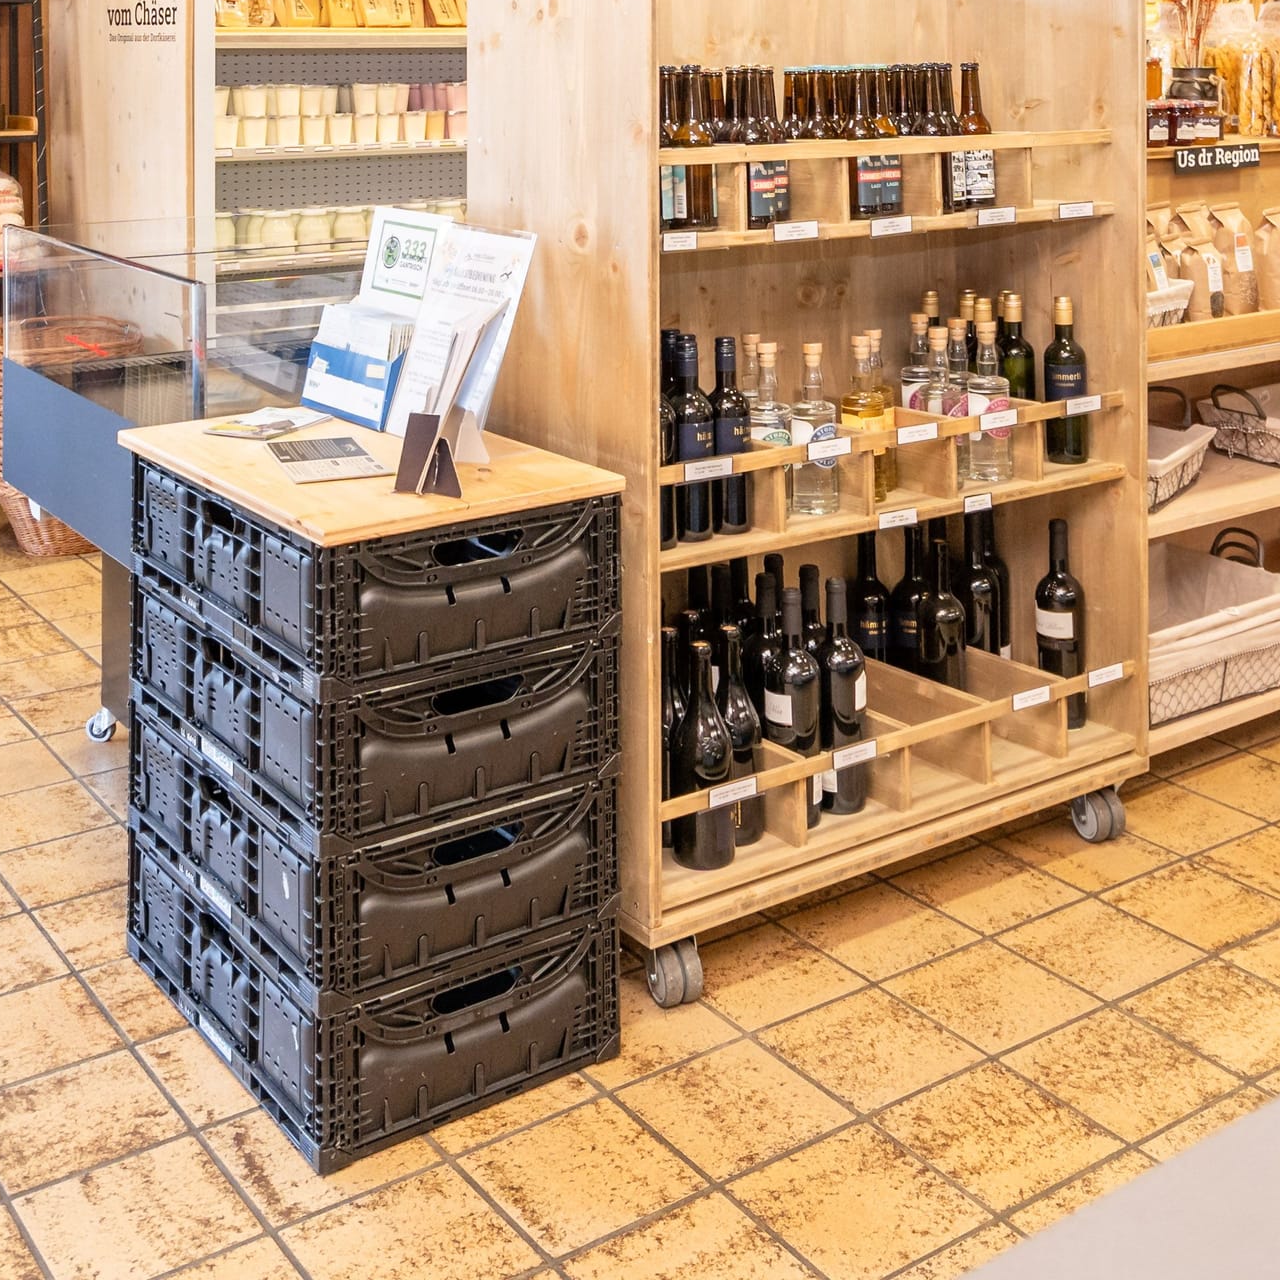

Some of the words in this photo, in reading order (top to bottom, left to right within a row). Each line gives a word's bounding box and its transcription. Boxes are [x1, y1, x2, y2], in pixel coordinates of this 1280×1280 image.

[107, 7, 132, 26] vom
[134, 0, 177, 26] Chäser
[1176, 151, 1196, 168] Us
[1198, 147, 1213, 166] dr
[1215, 146, 1259, 168] Region
